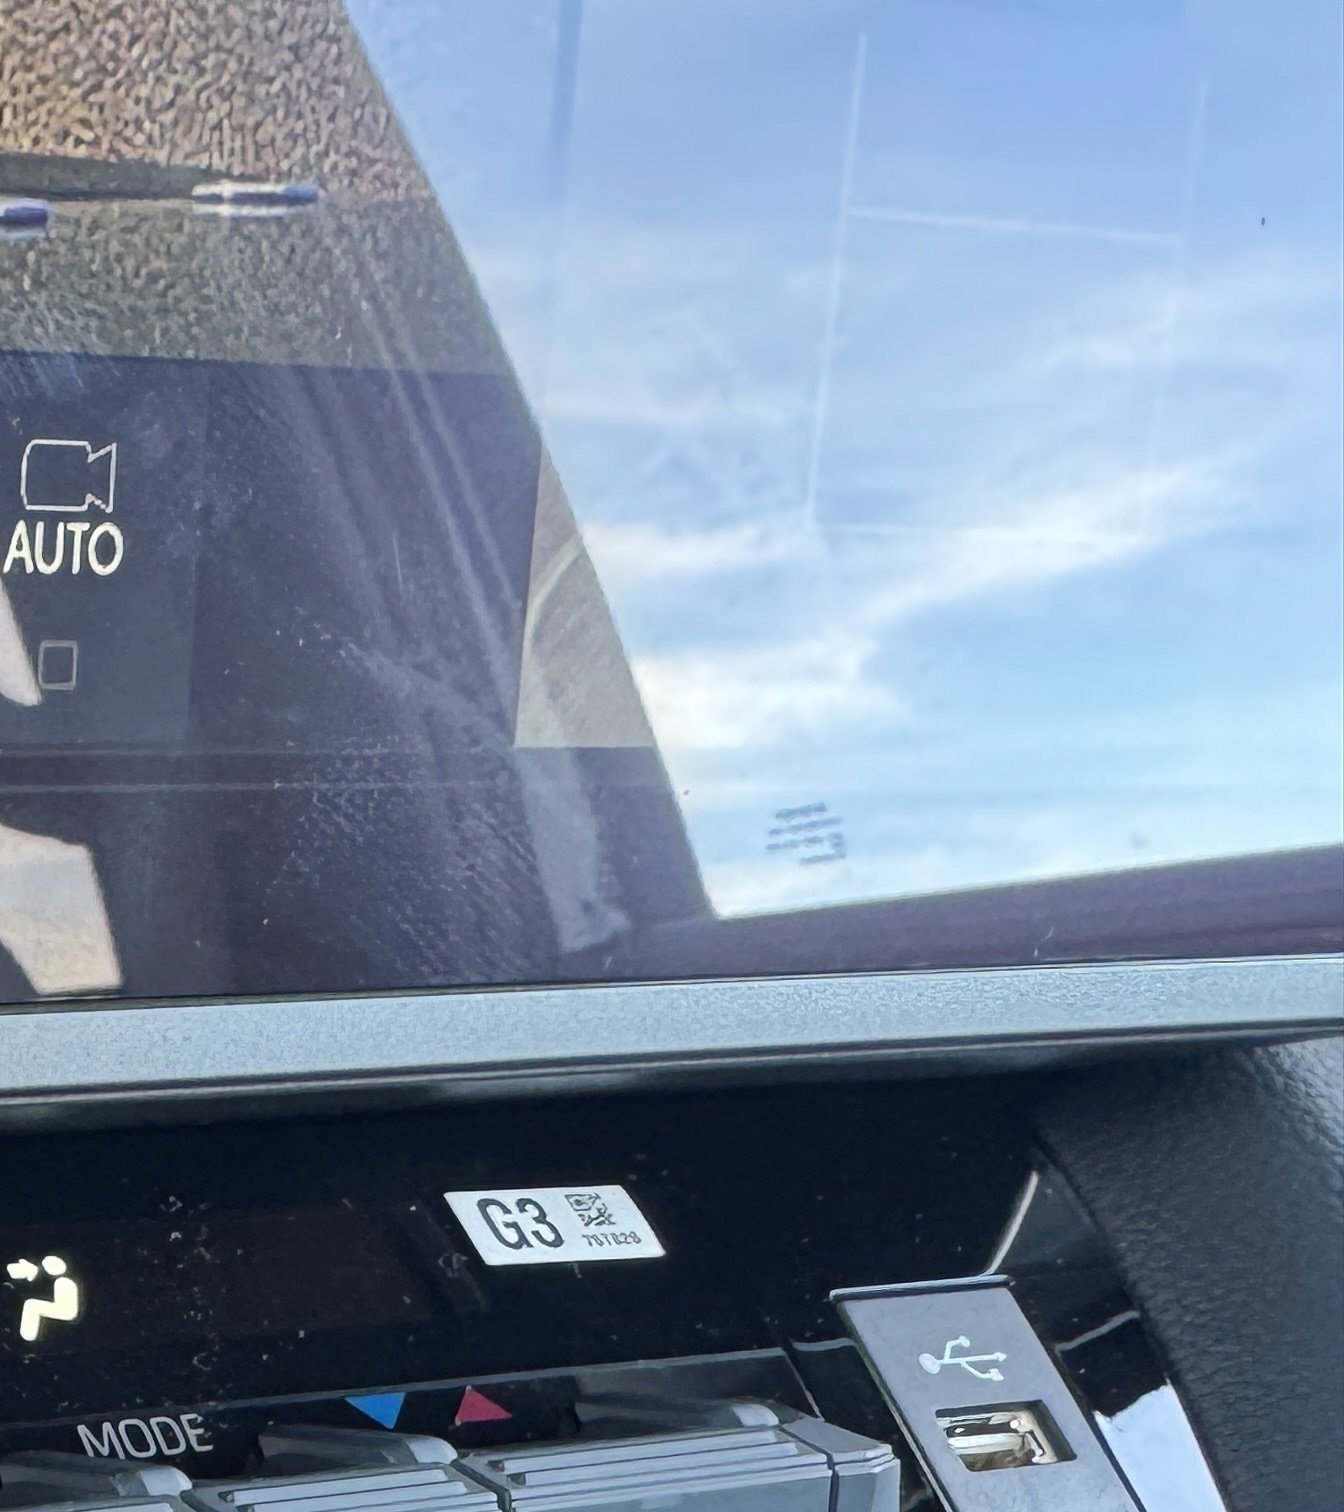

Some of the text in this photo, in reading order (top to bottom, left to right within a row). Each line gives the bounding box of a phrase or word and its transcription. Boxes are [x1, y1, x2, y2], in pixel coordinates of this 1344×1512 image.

[3, 520, 125, 576] AUTO
[477, 1198, 566, 1250] G3
[76, 1412, 214, 1460] MODE
